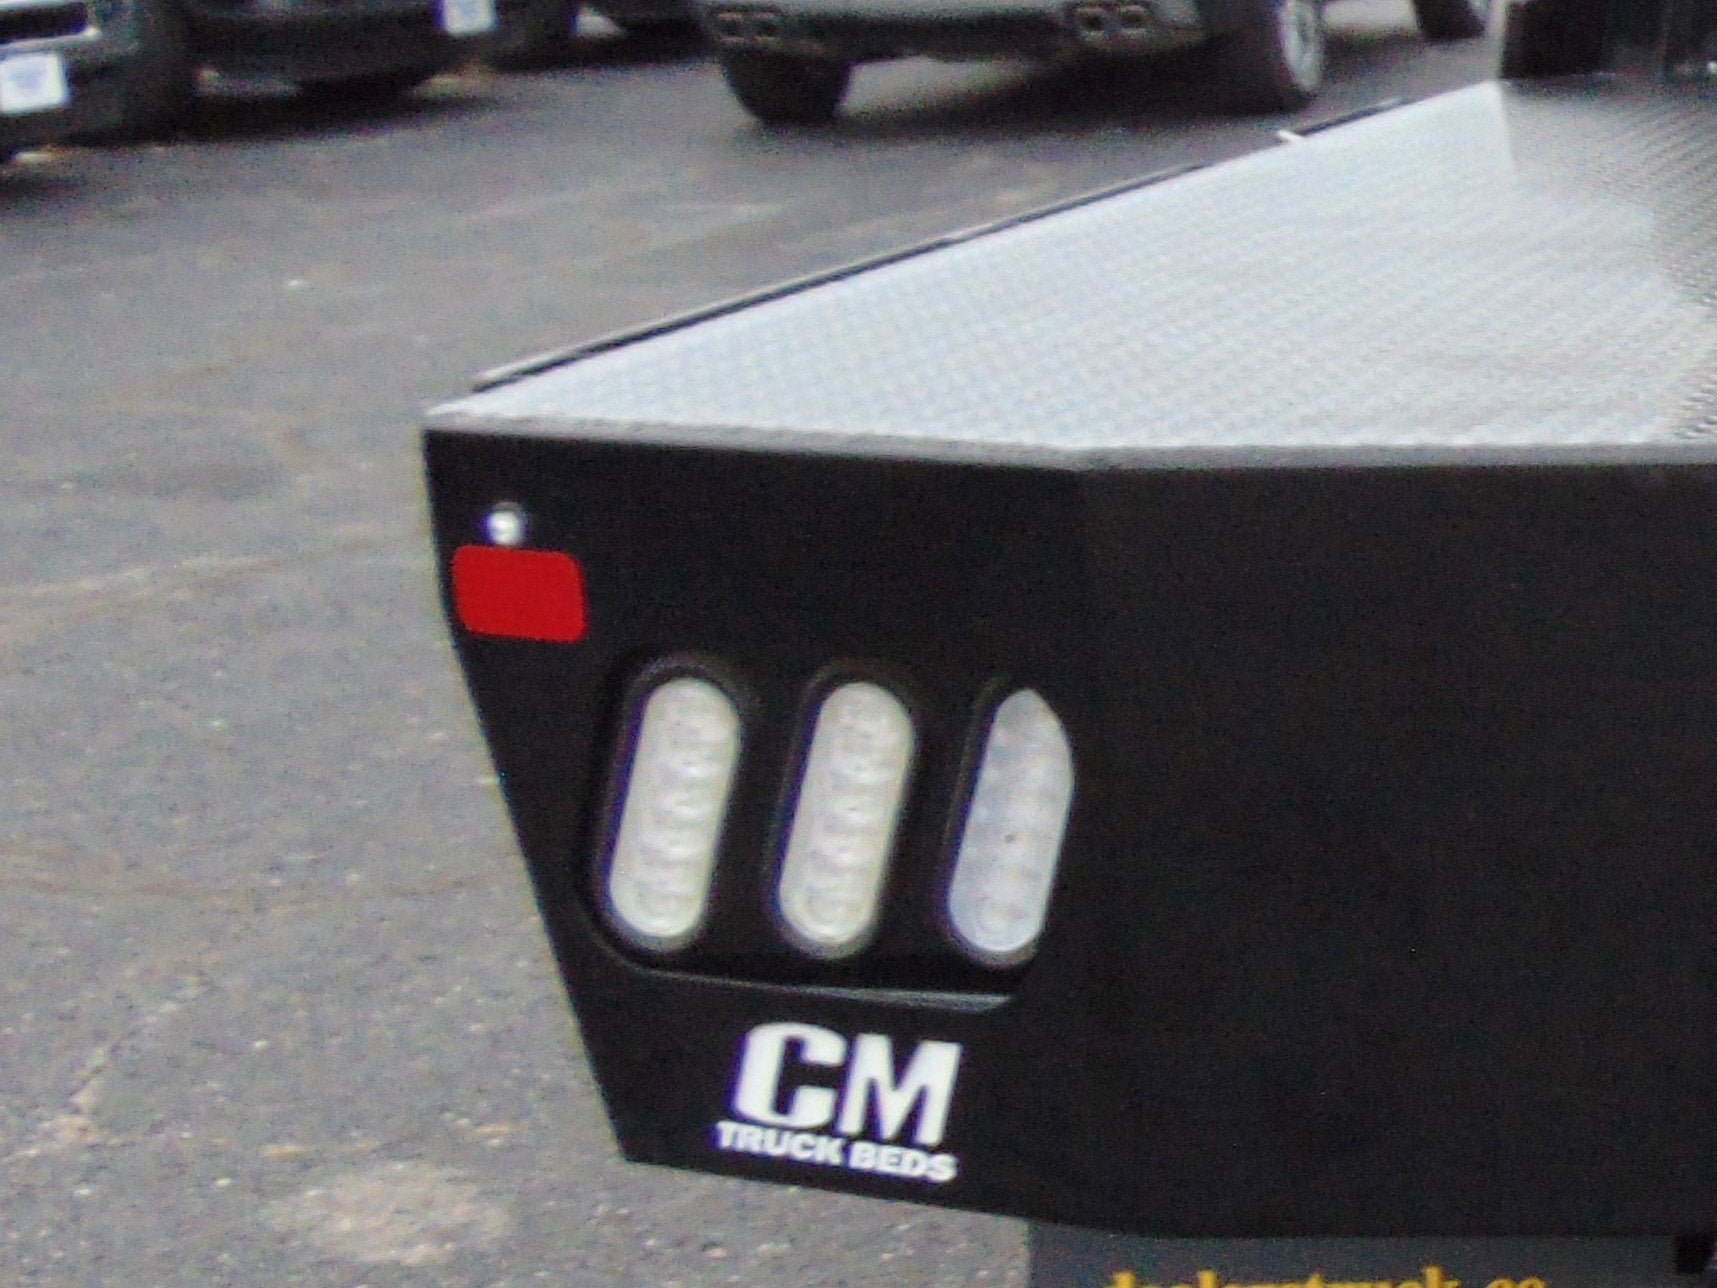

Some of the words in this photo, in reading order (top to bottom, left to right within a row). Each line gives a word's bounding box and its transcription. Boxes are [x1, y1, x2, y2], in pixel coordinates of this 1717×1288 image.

[734, 1022, 962, 1146] CM
[715, 1120, 844, 1165] TRUCK
[848, 1140, 958, 1182] BEDS
